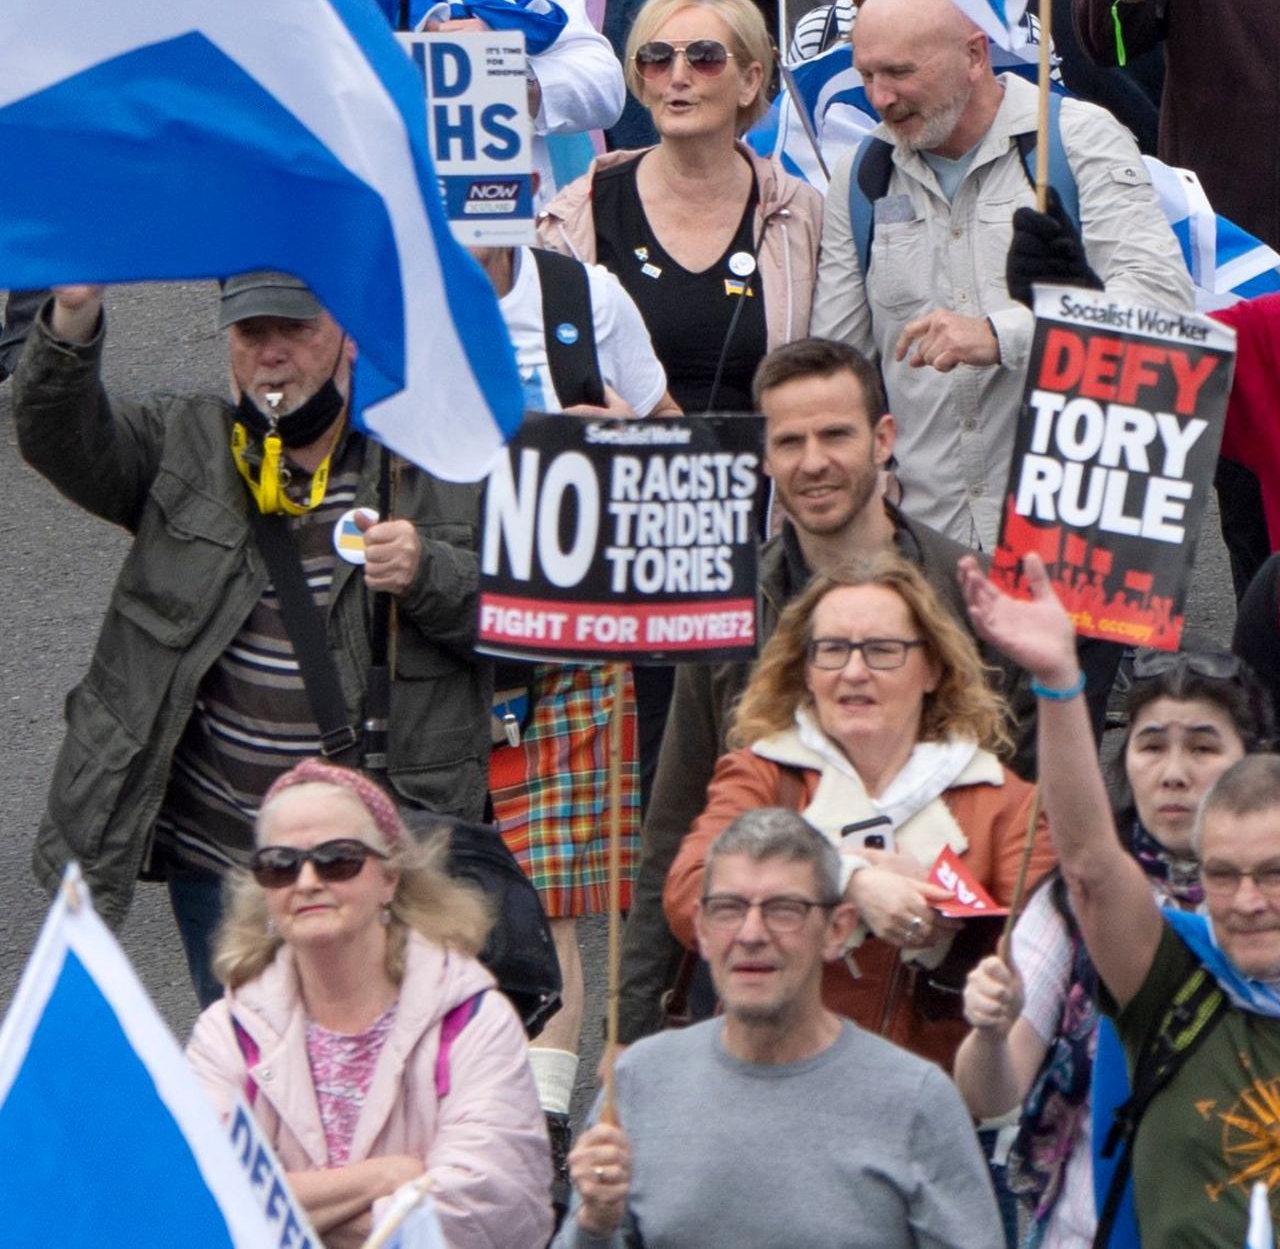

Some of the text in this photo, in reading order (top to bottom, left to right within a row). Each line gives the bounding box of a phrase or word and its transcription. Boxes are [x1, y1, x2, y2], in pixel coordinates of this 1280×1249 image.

[433, 102, 522, 162] HS
[469, 184, 519, 199] NOW
[1059, 295, 1212, 343] Socialist Worker
[1036, 328, 1219, 416] DEFY
[1030, 390, 1208, 480] TORY
[609, 452, 759, 502] RACISTS
[1014, 453, 1194, 545] RULE
[480, 446, 600, 589] NO
[608, 499, 753, 548] TRIDENT
[606, 545, 735, 595] TORIES
[480, 604, 754, 643] FIGHT FOR INDYREF2
[1098, 617, 1154, 643] occupy
